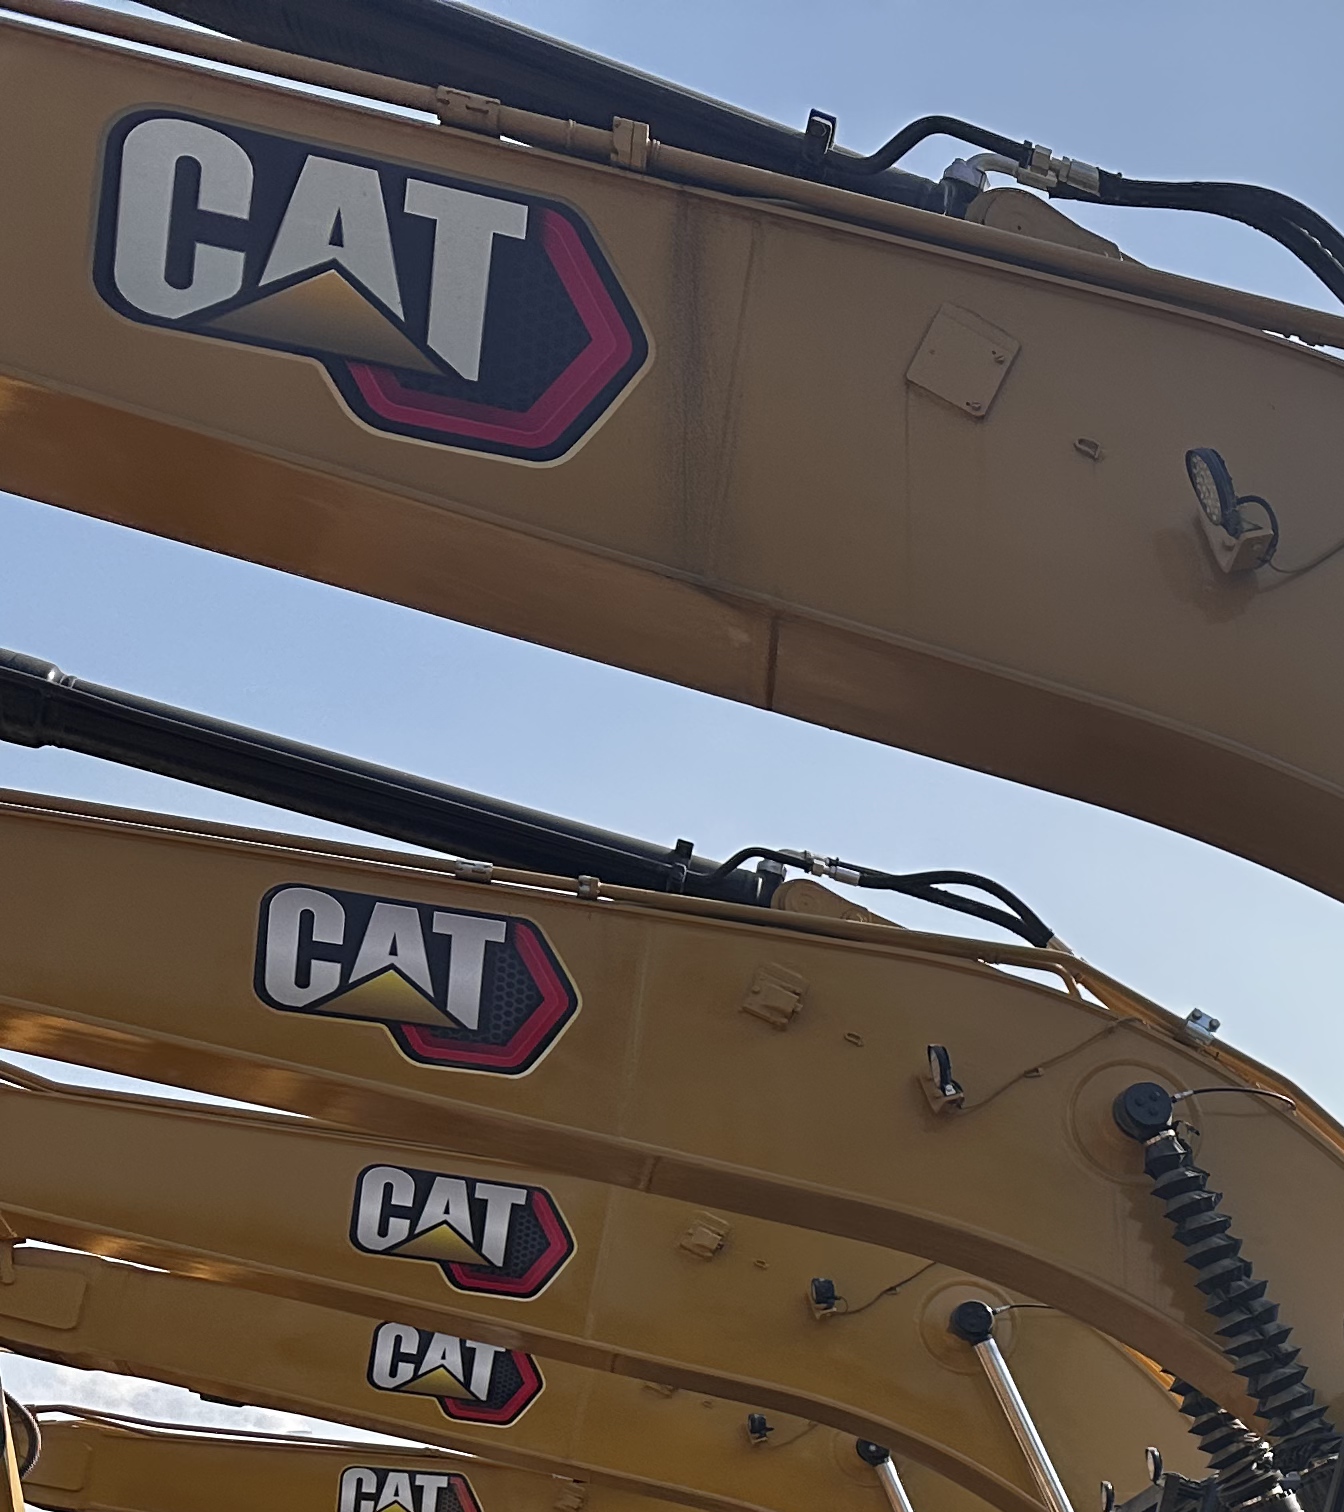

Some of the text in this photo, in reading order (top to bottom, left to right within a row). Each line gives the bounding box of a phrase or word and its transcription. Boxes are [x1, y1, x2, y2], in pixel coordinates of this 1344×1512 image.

[113, 117, 529, 382] CAT
[265, 886, 506, 1031] CAT
[357, 1165, 528, 1267] CAT
[375, 1322, 505, 1401] CAT
